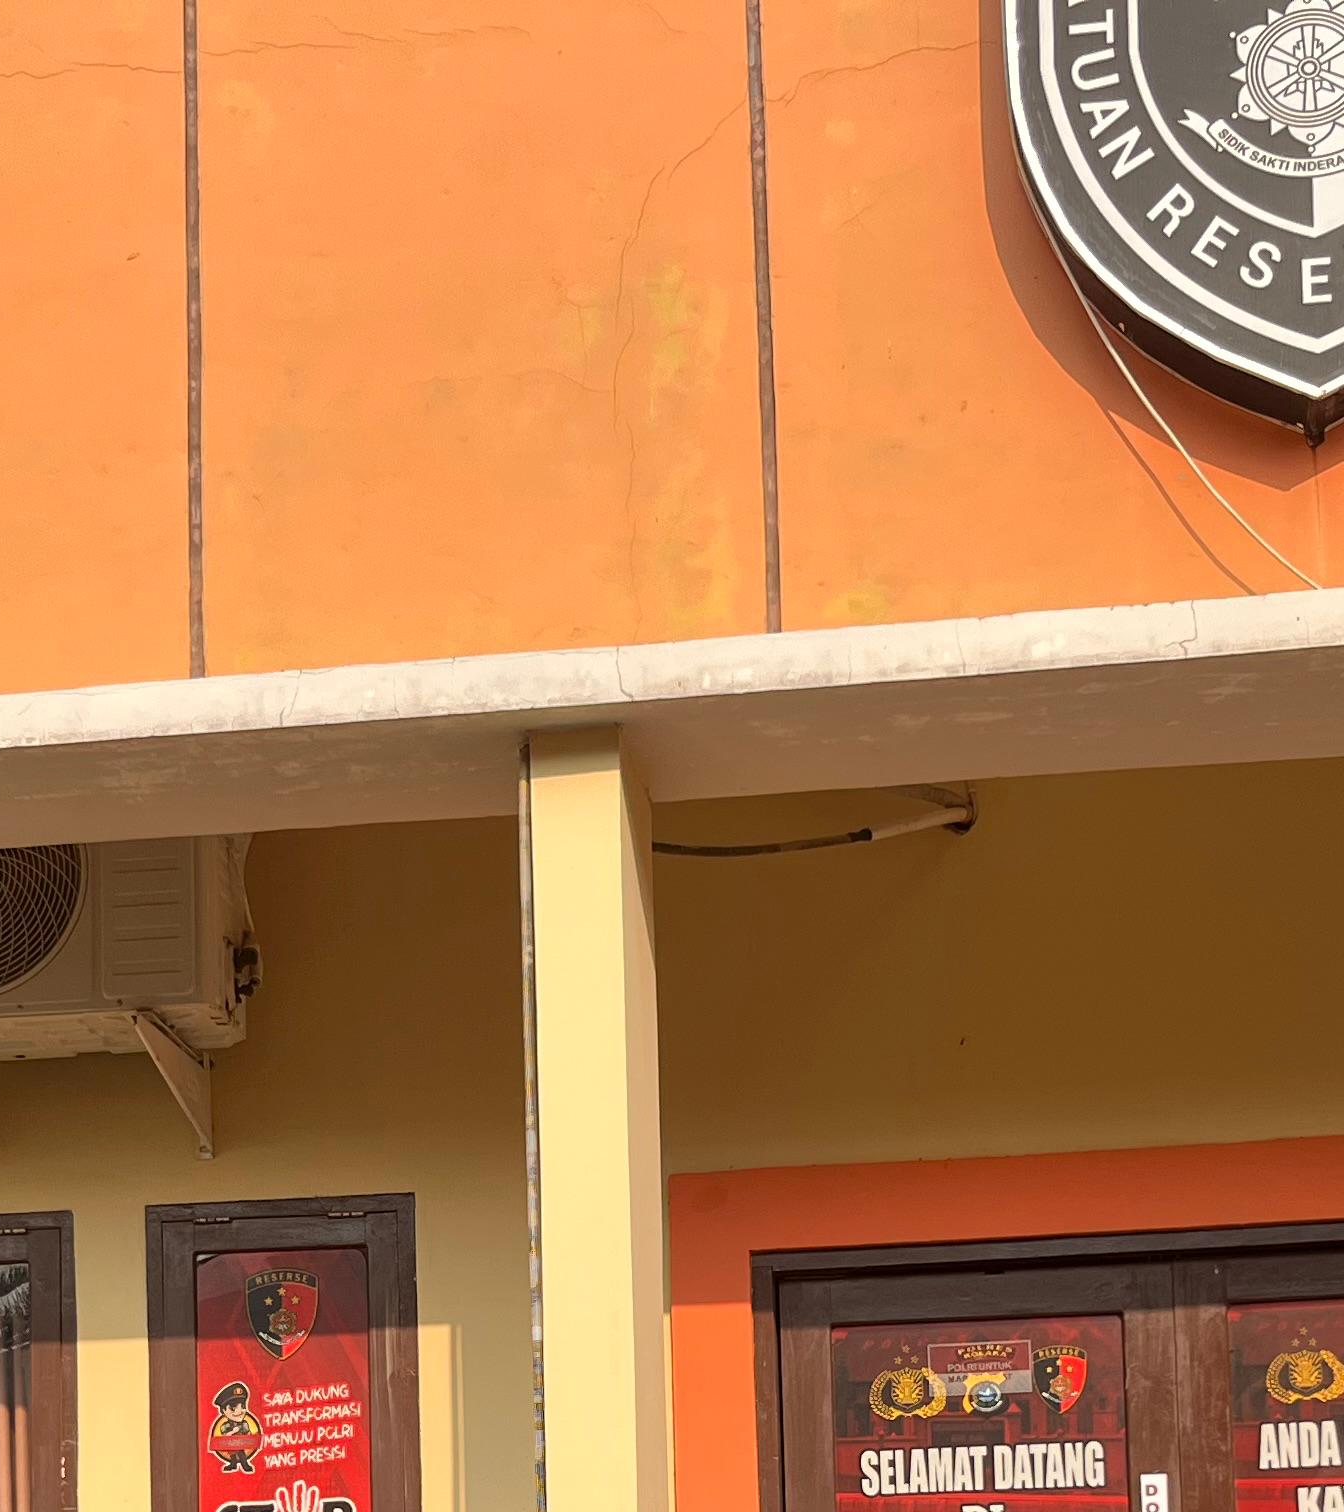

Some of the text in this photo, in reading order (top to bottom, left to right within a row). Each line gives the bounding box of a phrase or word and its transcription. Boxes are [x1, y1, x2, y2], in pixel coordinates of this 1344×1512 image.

[1067, 0, 1154, 179] TUAN
[1218, 128, 1251, 156] SIDIK
[1249, 151, 1290, 172] SAKTI
[255, 1271, 309, 1285] RESERSE
[264, 1384, 350, 1407] SAYA DUKUNG
[264, 1402, 361, 1427] TRANSFORMASI
[264, 1430, 313, 1448] MENUJU
[317, 1424, 354, 1441] POLRI
[1259, 1420, 1342, 1470] ANDA
[264, 1445, 346, 1468] YANG PRESISI
[860, 1441, 1105, 1497] SELAMAT DATANG
